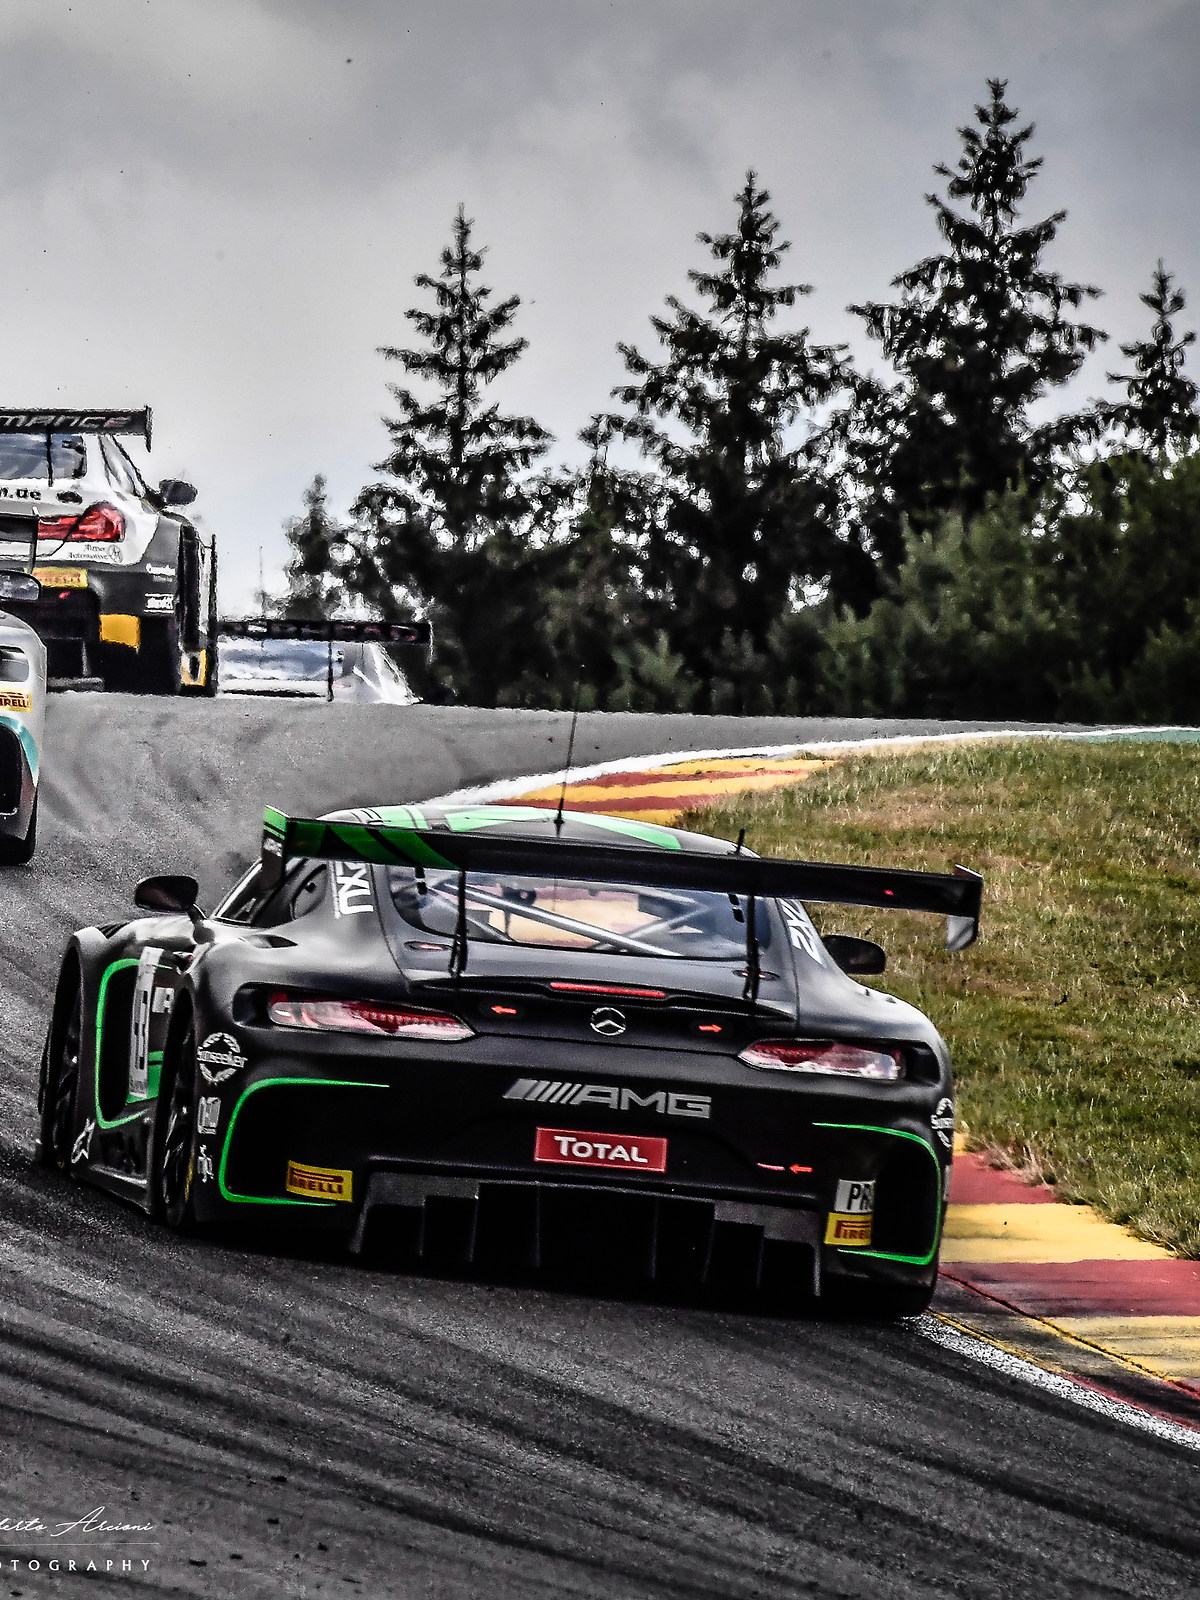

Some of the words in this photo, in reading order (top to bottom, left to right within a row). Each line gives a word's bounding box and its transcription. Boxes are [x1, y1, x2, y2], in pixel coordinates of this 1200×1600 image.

[569, 1084, 712, 1119] AMG
[554, 1135, 649, 1164] TOTAL
[288, 1166, 344, 1195] PIRELLI
[834, 1220, 872, 1239] PIRE
